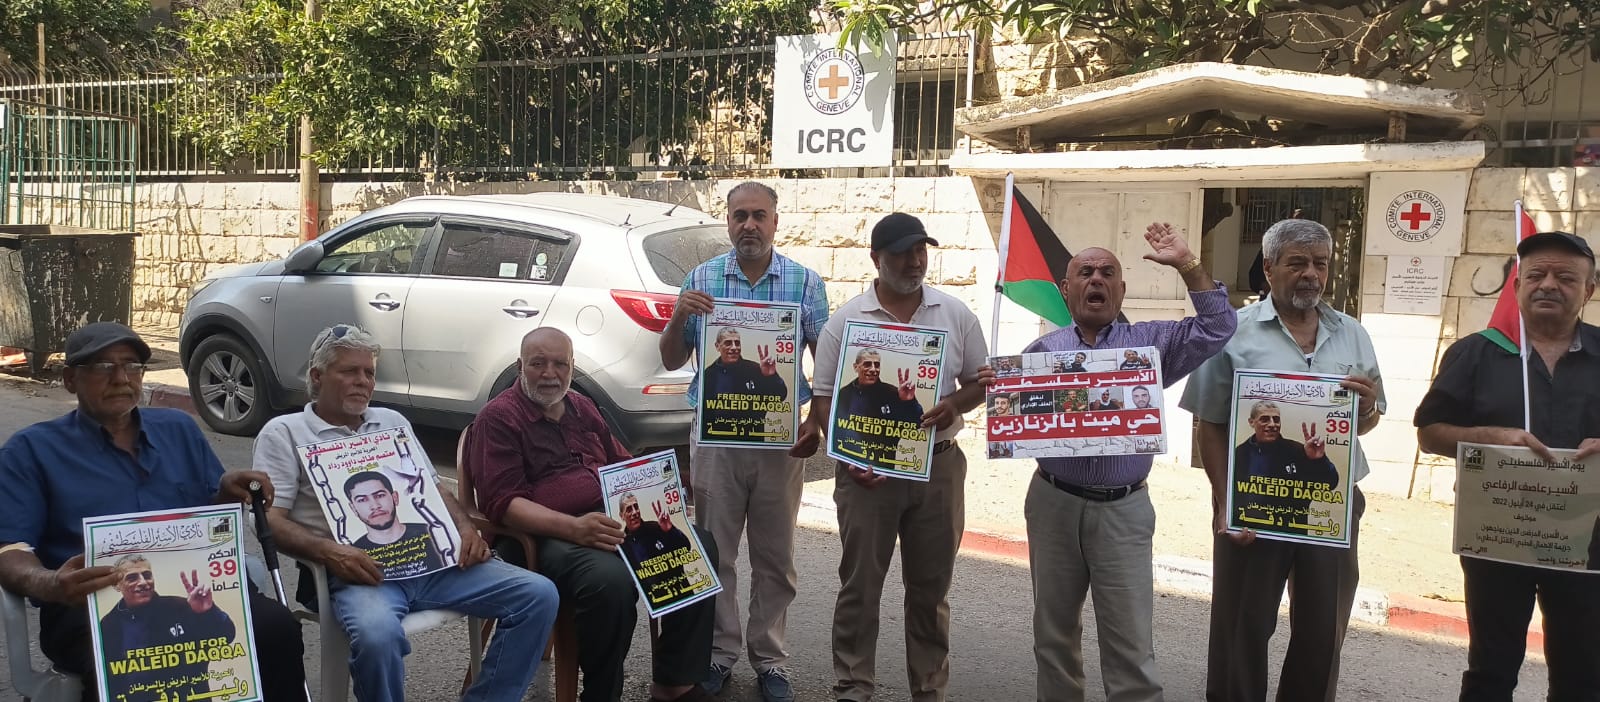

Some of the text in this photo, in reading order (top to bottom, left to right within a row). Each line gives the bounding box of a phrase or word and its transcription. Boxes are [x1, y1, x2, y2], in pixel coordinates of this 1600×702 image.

[806, 62, 818, 98] COMITE
[798, 127, 866, 154] ICRC
[1388, 191, 1445, 230] COMITE INTERNATIONAL
[1396, 230, 1431, 241] GENEVE
[776, 333, 795, 341] الحكم
[776, 342, 794, 354] 39
[918, 358, 940, 366] الحكم
[917, 366, 938, 379] 39
[1094, 370, 1155, 387] الأسير
[707, 400, 791, 412] WALEID DAQQA
[1327, 411, 1351, 419] الحكم
[707, 423, 745, 436] دقة
[838, 418, 927, 441] WALEID DAQQA
[850, 415, 917, 430] FREEDOM FOR
[992, 413, 1160, 436] حي ميت بالزنازين
[1326, 420, 1350, 434] 39
[374, 433, 391, 446] نادي
[305, 442, 347, 460] الفلسطيني
[838, 440, 875, 461] دقة
[1570, 464, 1585, 473] يوم
[664, 482, 679, 493] الحكم
[1250, 476, 1330, 490] FREEDOM FOR
[1482, 479, 1579, 497] الأسير عاصف الرفاعي
[665, 491, 680, 505] 39
[1238, 481, 1344, 504] WALEID DAQQA
[1492, 497, 1508, 506] 2022
[1534, 503, 1546, 512] في
[1239, 507, 1283, 527] دقة
[208, 548, 237, 562] الحكم
[640, 547, 689, 568] FREEDOM FOR
[209, 559, 237, 578] 39
[637, 550, 701, 579] WALEID DAQQA
[127, 637, 228, 659] FREEDOM FOR
[110, 643, 246, 675] WALEID DAQQA
